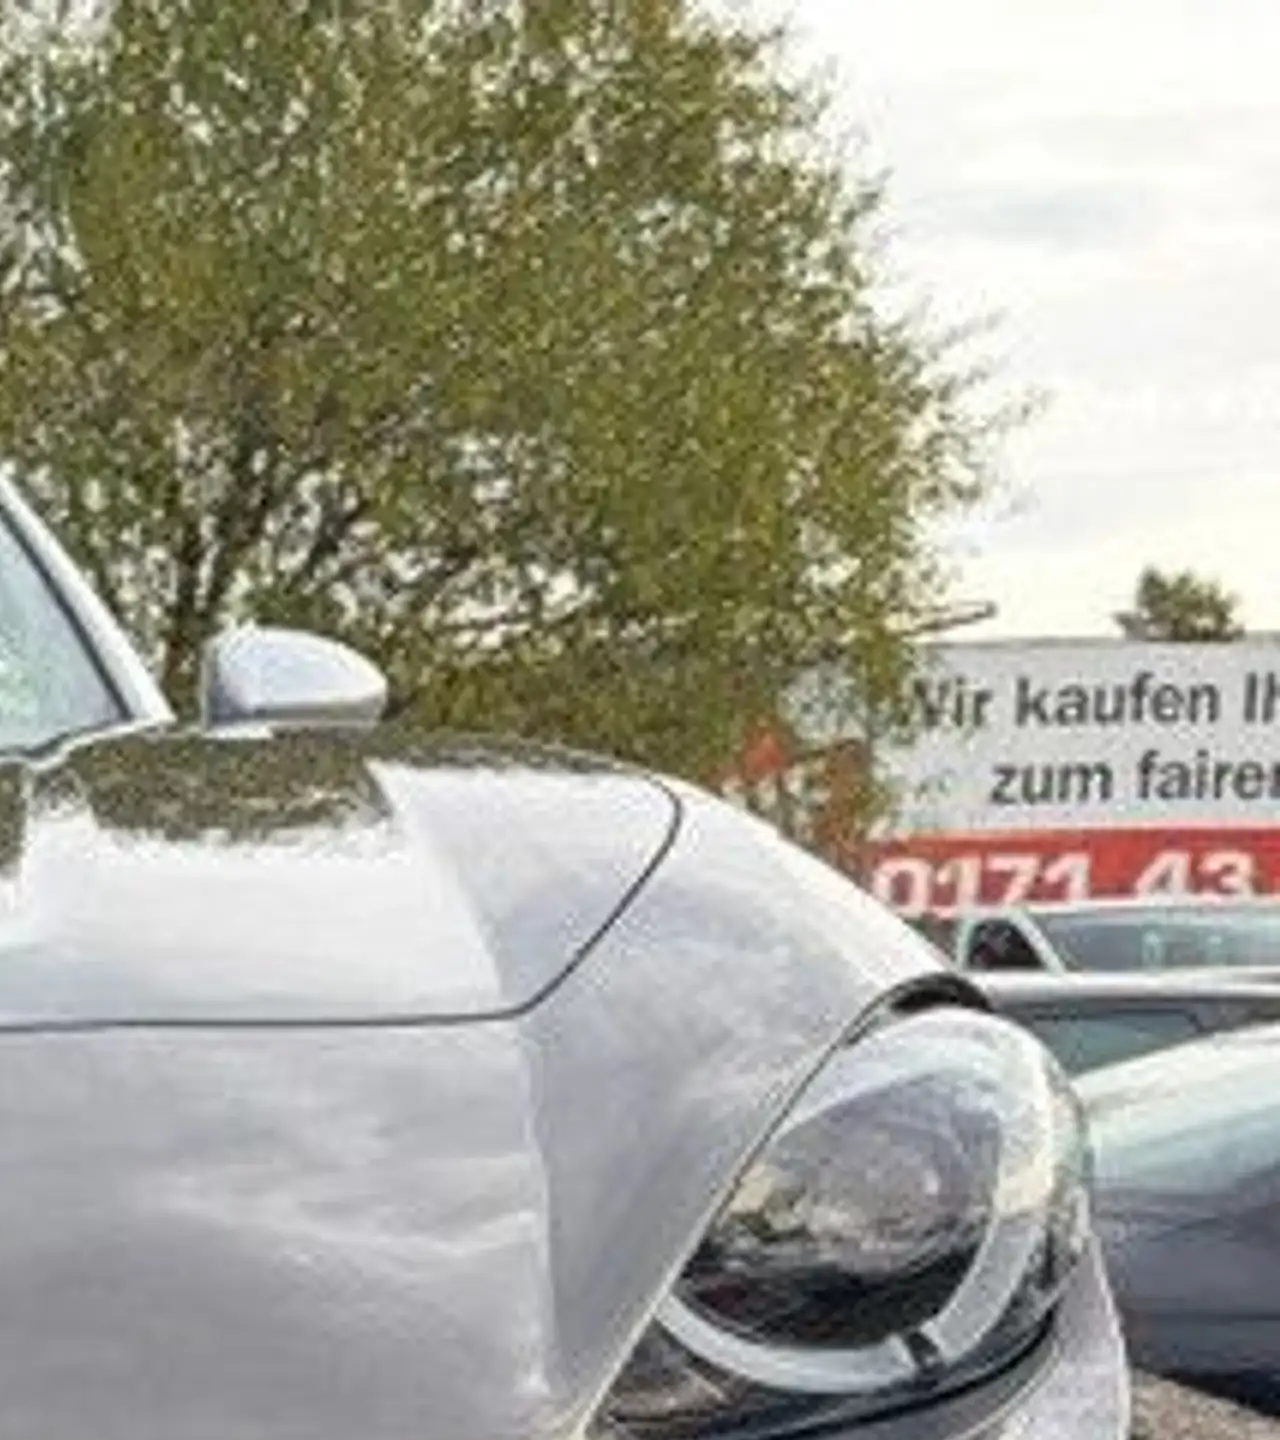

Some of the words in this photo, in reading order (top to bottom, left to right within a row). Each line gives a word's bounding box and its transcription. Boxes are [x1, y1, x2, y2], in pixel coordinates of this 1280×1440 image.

[1014, 671, 1222, 728] kaufen
[990, 764, 1114, 804] zum
[1137, 749, 1280, 801] faire
[872, 850, 1092, 919] 0171
